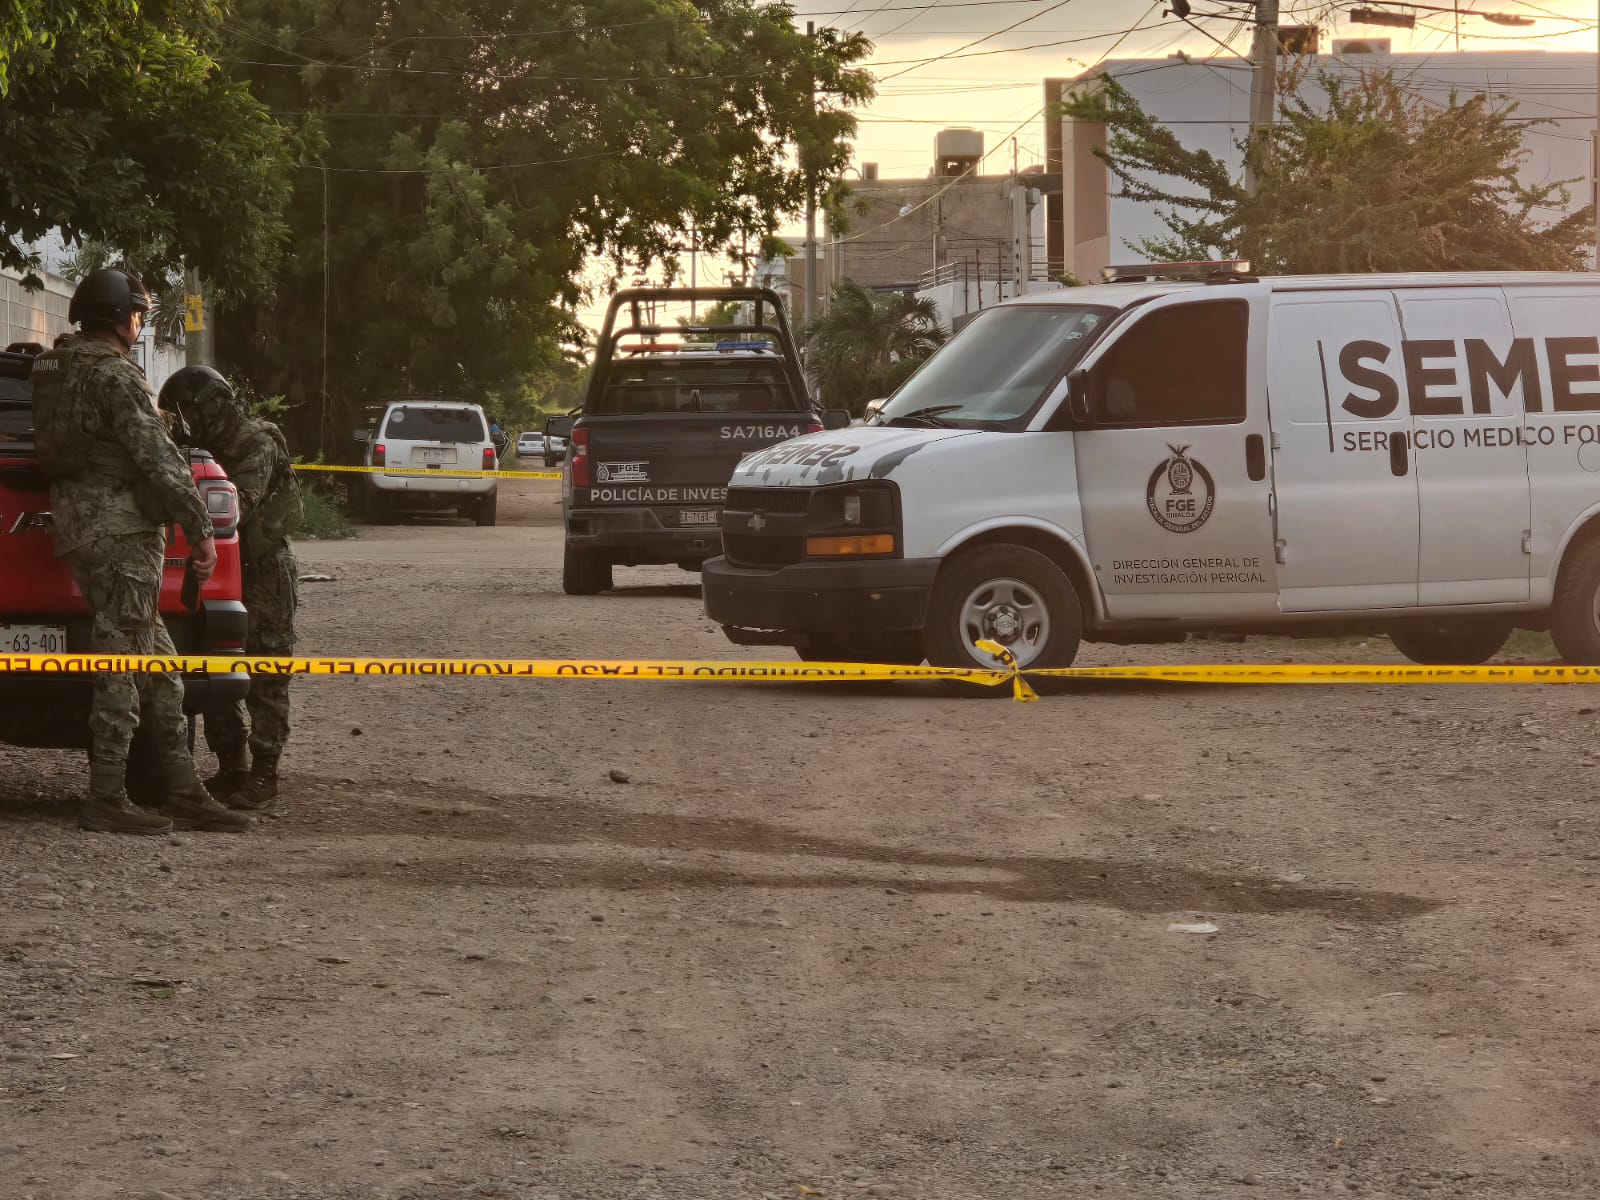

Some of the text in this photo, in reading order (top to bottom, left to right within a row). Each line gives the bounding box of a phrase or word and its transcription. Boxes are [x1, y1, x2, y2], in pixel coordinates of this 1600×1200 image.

[1338, 336, 1600, 418] SEME
[720, 425, 801, 439] SA716A4
[1343, 424, 1600, 451] SERICIO MEDICO FO
[619, 464, 640, 472] FGE
[590, 487, 654, 501] POLICÍA
[657, 489, 678, 501] DE
[1165, 499, 1196, 512] FGE
[1112, 557, 1260, 570] DIRECCIÓN GENERAL DE
[1113, 571, 1267, 585] INVESTIGACIÓN PERICIAL
